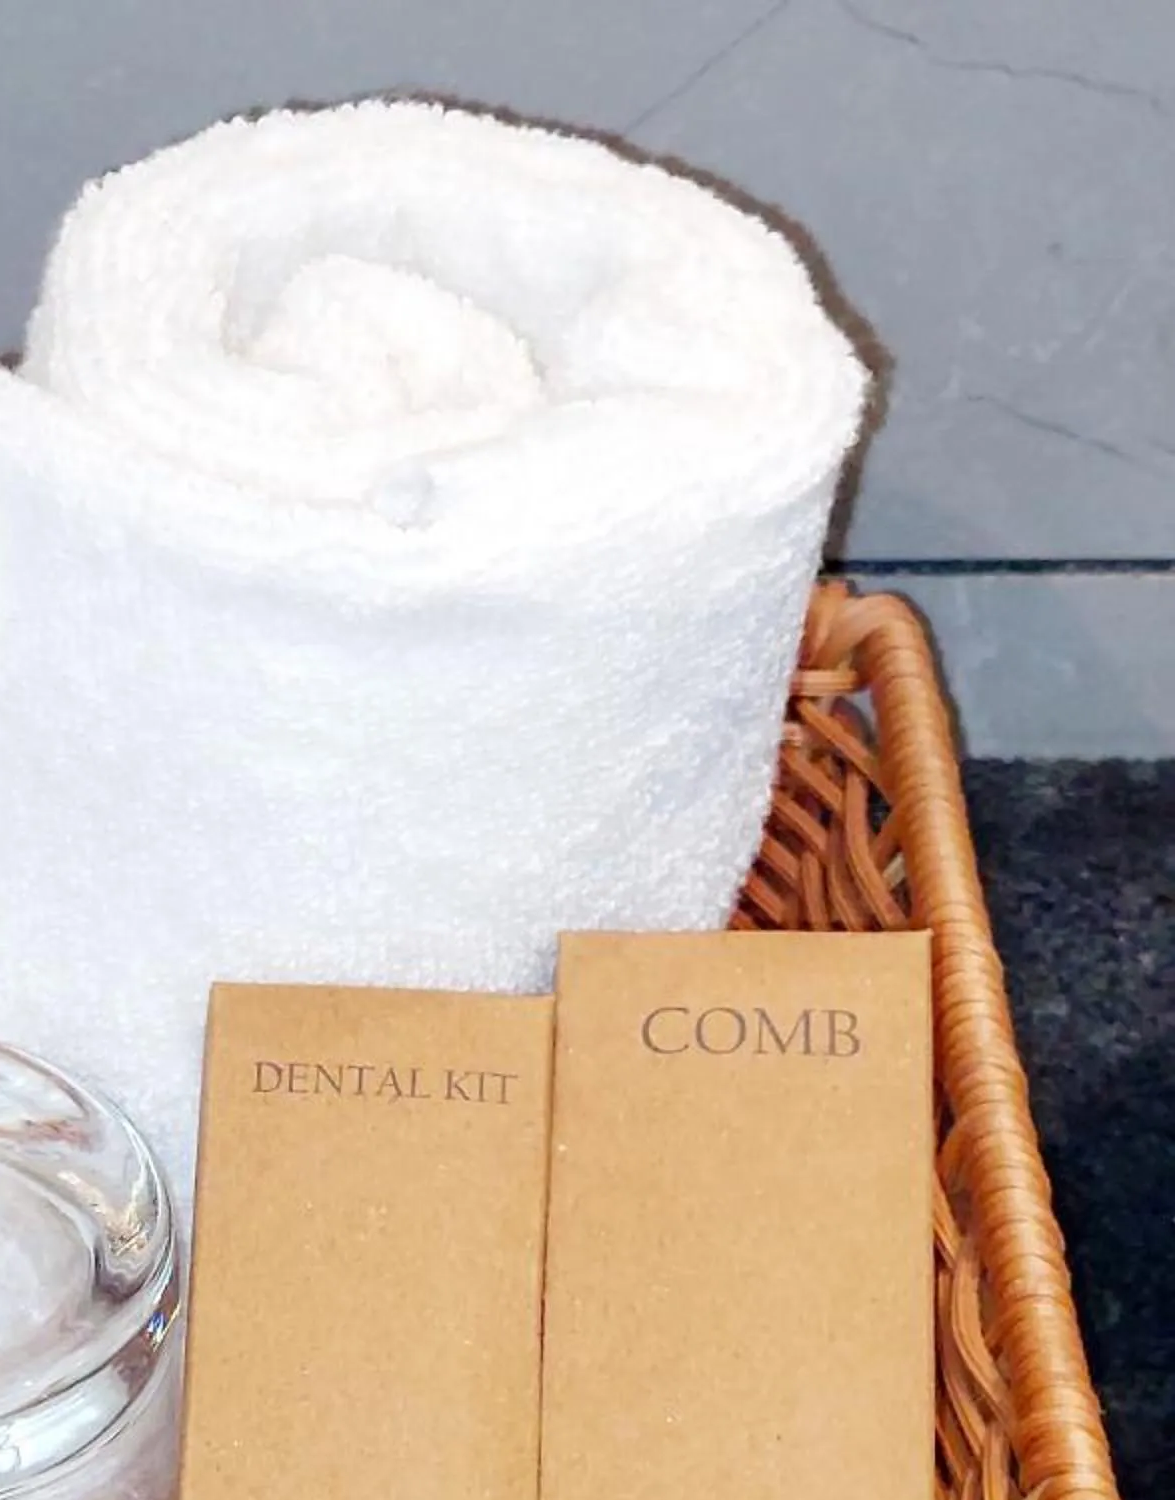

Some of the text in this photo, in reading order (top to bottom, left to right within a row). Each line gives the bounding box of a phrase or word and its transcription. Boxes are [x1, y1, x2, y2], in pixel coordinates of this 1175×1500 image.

[641, 1006, 861, 1057] COMB
[252, 1060, 520, 1105] DENTAL KIT
